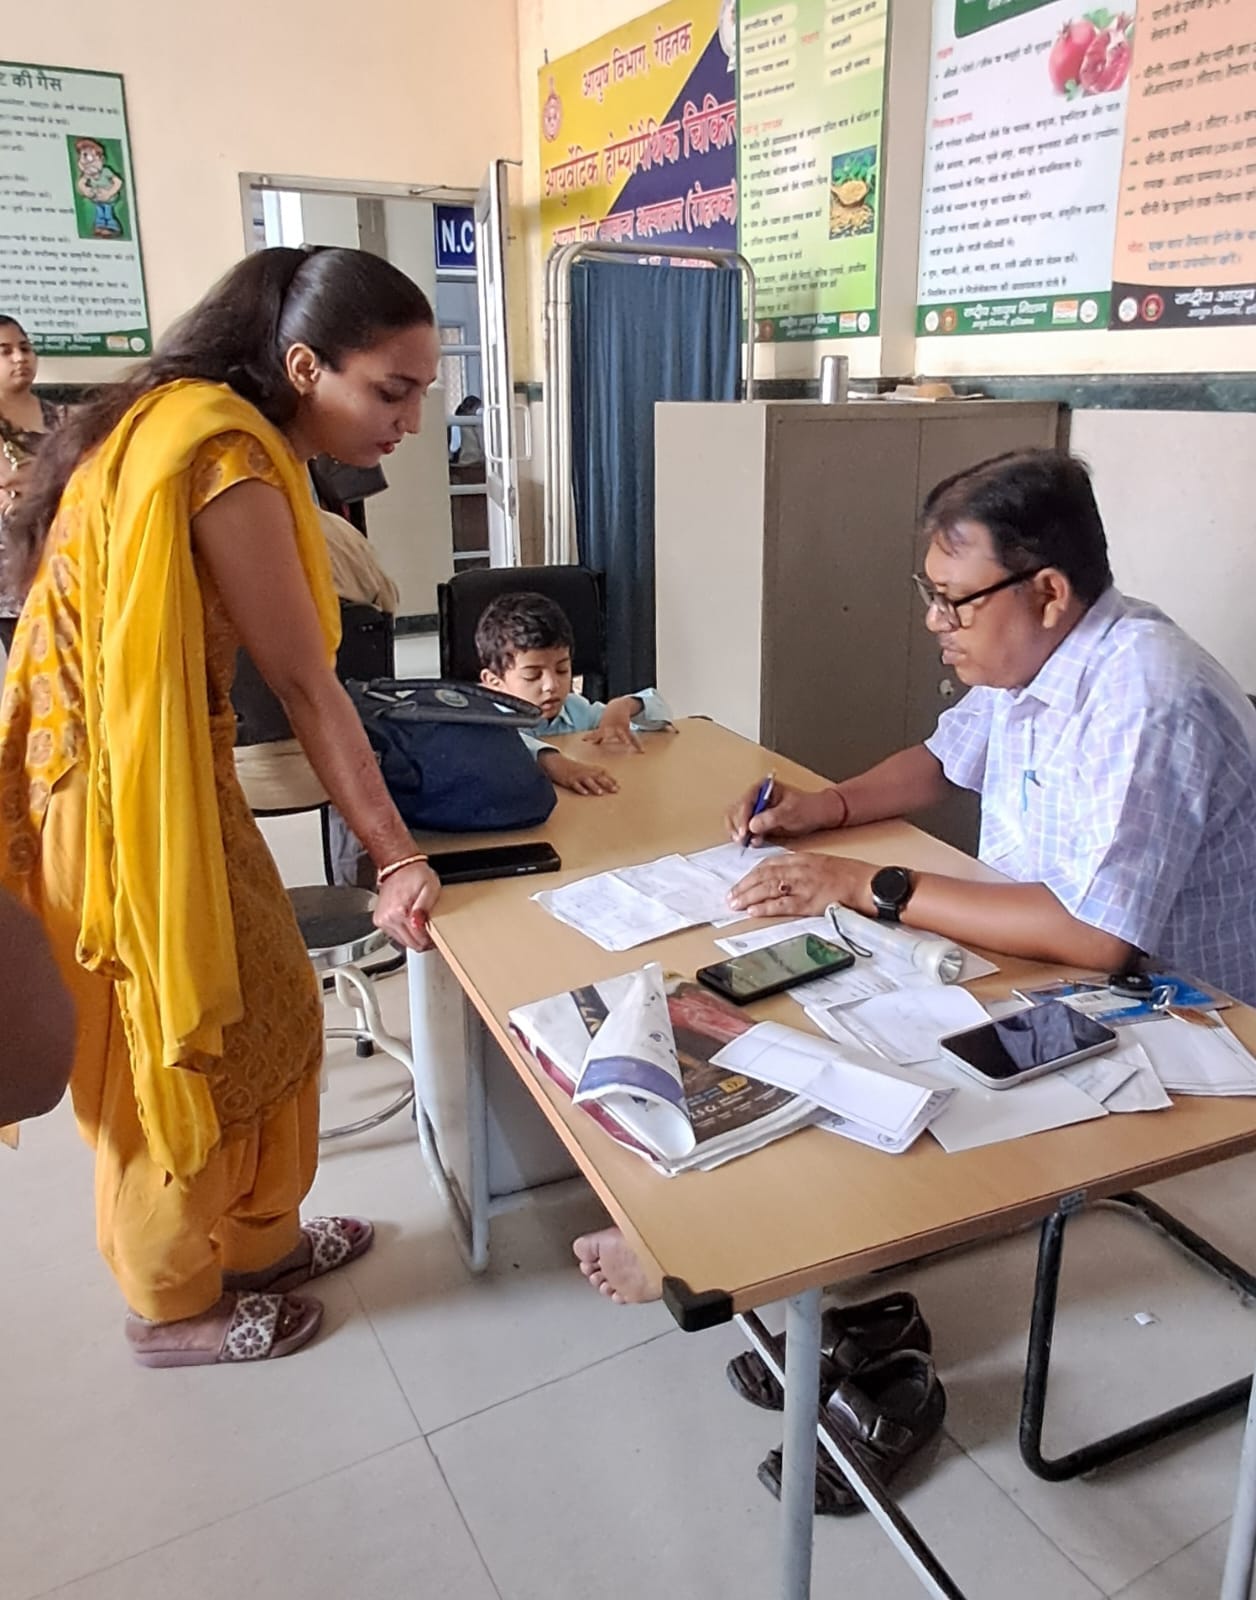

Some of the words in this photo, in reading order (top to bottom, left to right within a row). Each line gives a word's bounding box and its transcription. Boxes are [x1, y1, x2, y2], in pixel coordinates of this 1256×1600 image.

[12, 70, 33, 89] की
[36, 71, 62, 92] गैस
[583, 64, 609, 102] आयुष
[613, 45, 650, 82] विभाग,
[654, 23, 693, 66] रोहतक
[545, 145, 599, 206] आयुर्वेदिक
[603, 118, 682, 184] होम्योपैथिक
[682, 94, 737, 158] चिकित
[442, 219, 475, 254] N.C
[636, 197, 684, 237] अस्पताल
